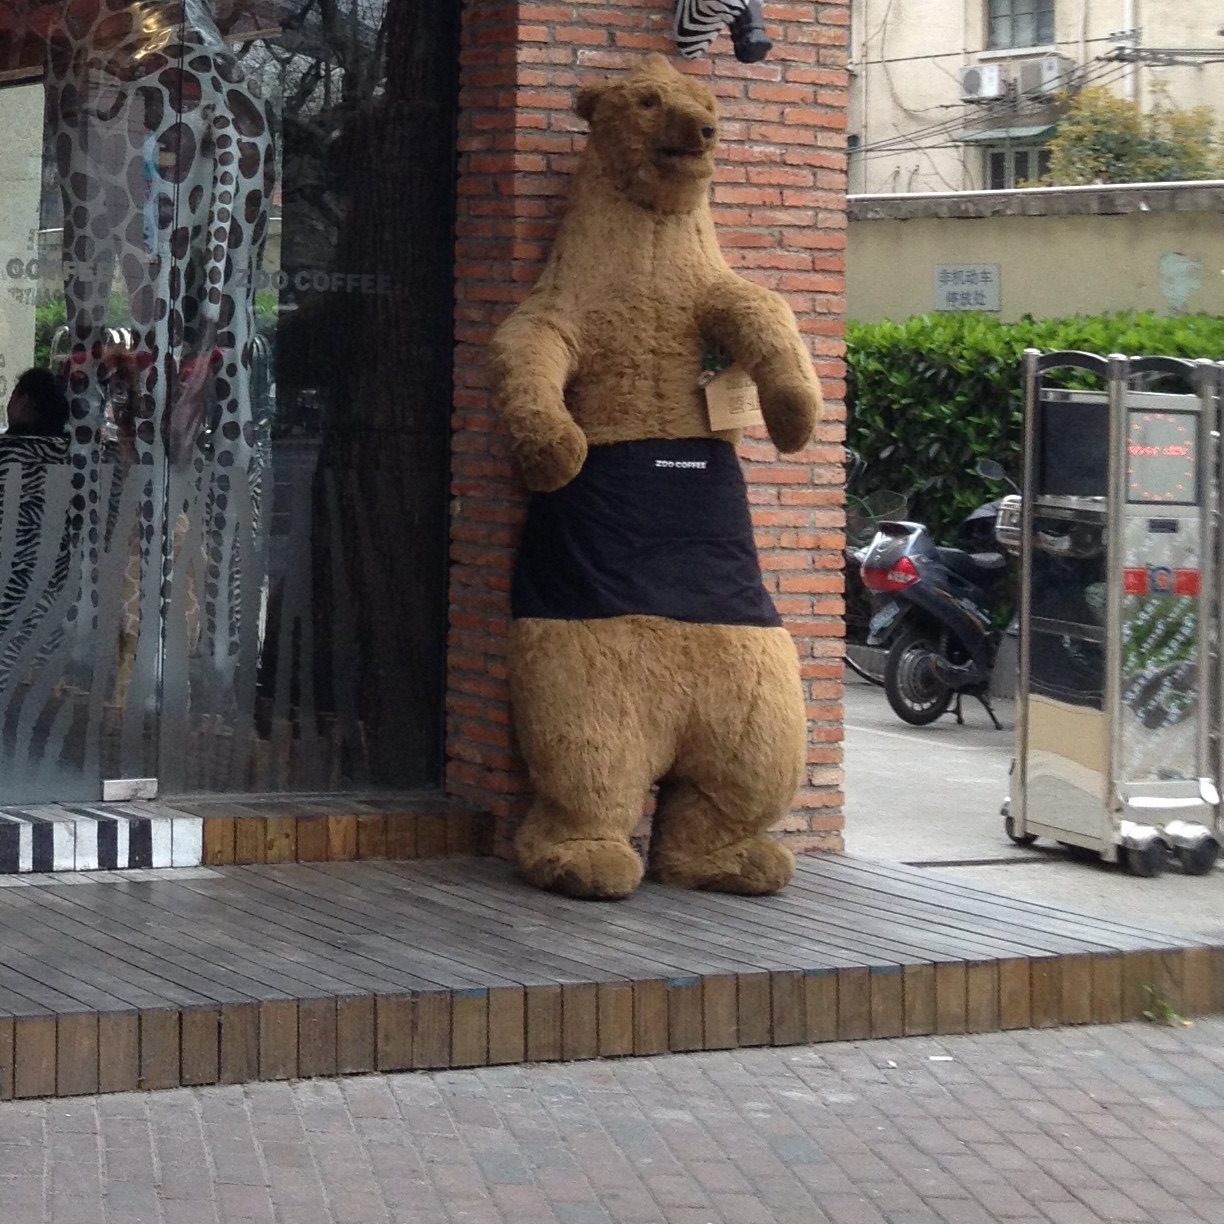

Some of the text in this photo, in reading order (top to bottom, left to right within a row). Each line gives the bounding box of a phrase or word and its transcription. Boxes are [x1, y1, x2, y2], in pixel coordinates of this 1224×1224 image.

[294, 270, 393, 295] COFFEE
[655, 460, 707, 469] ZOO COFFEE
